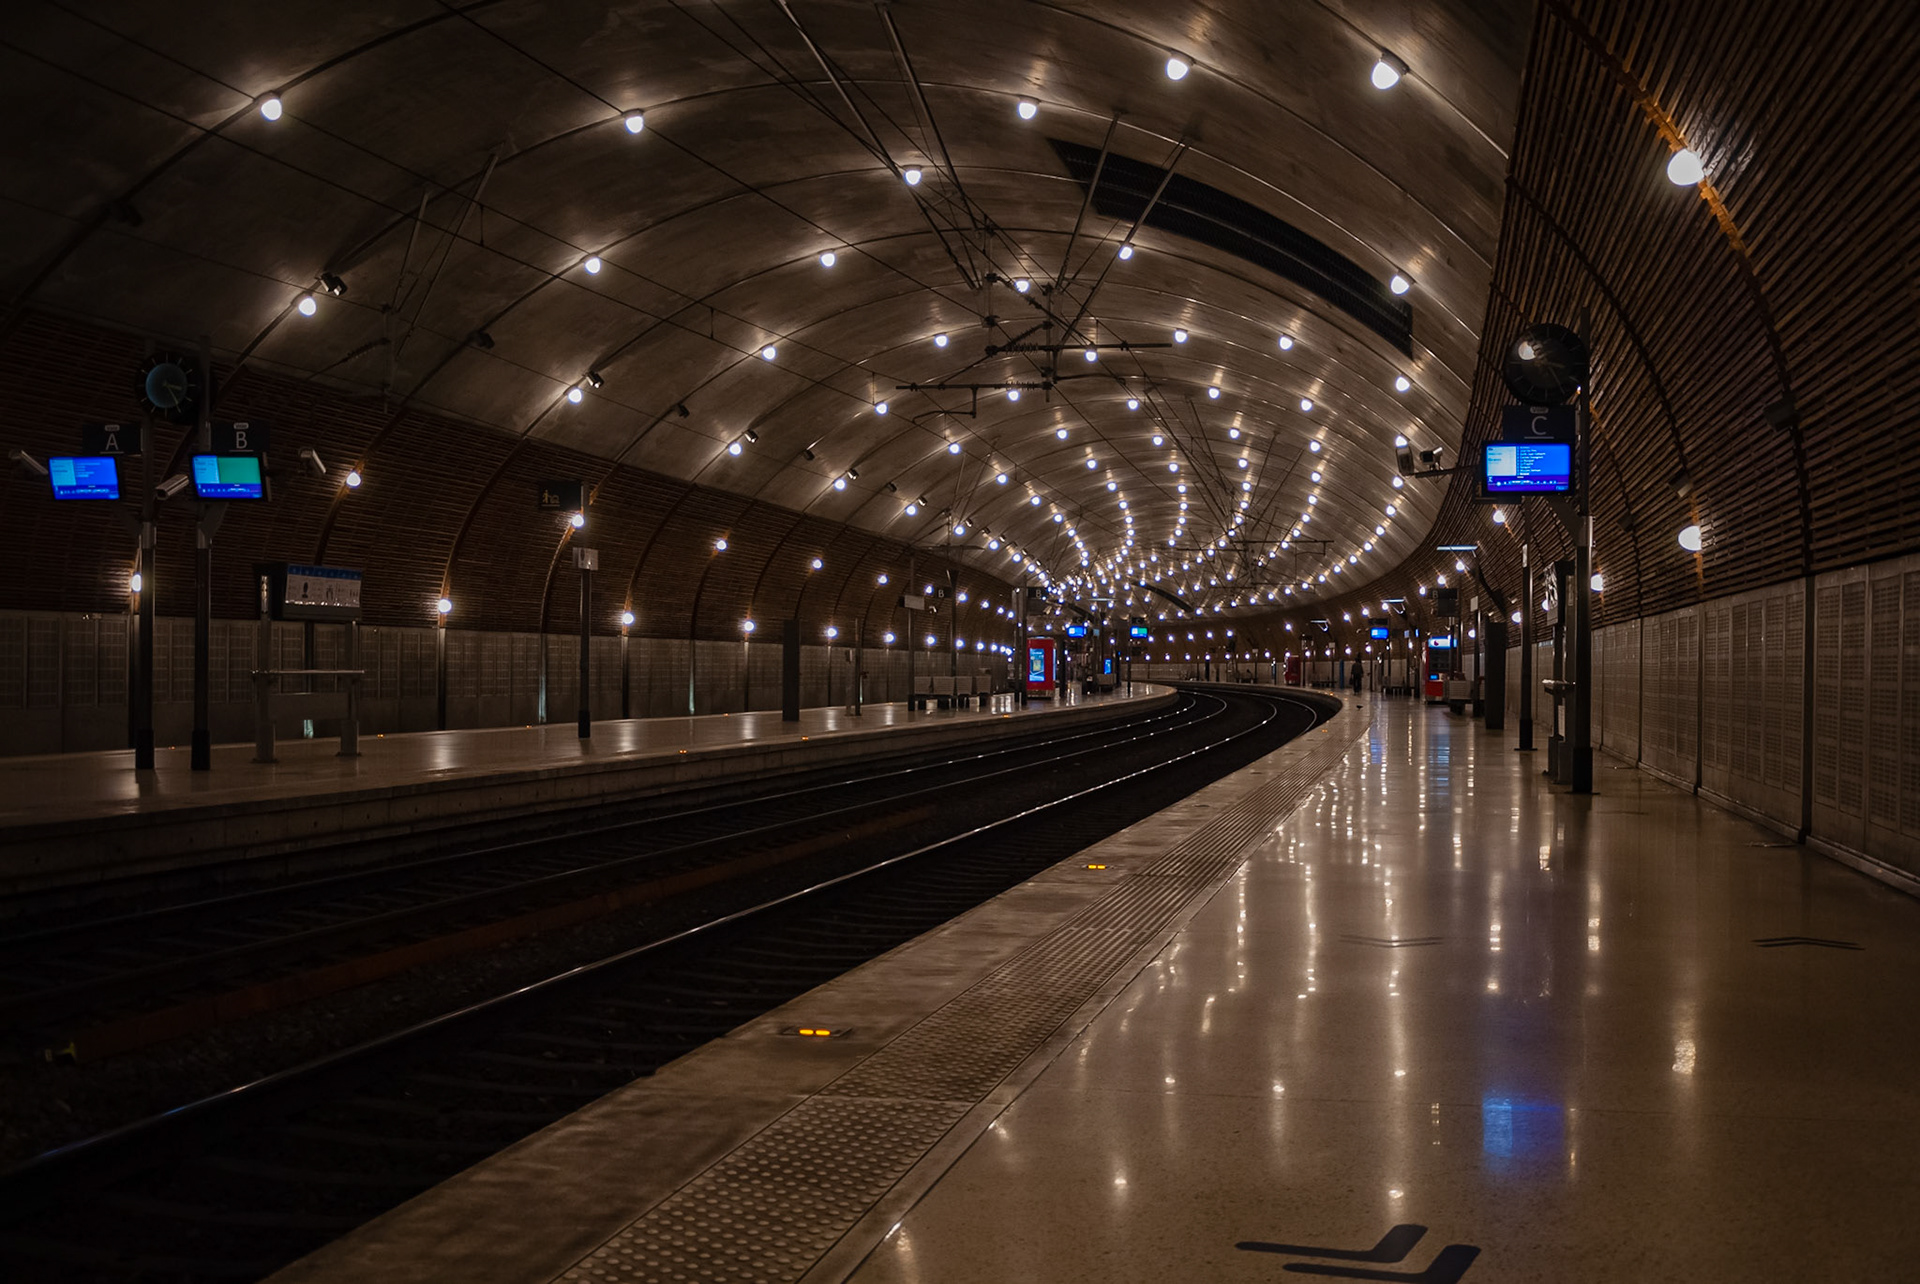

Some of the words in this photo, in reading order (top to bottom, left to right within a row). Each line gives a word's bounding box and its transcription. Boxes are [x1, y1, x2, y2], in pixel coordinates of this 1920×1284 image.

[1531, 415, 1548, 436] C
[105, 433, 119, 450] A
[236, 431, 248, 449] B
